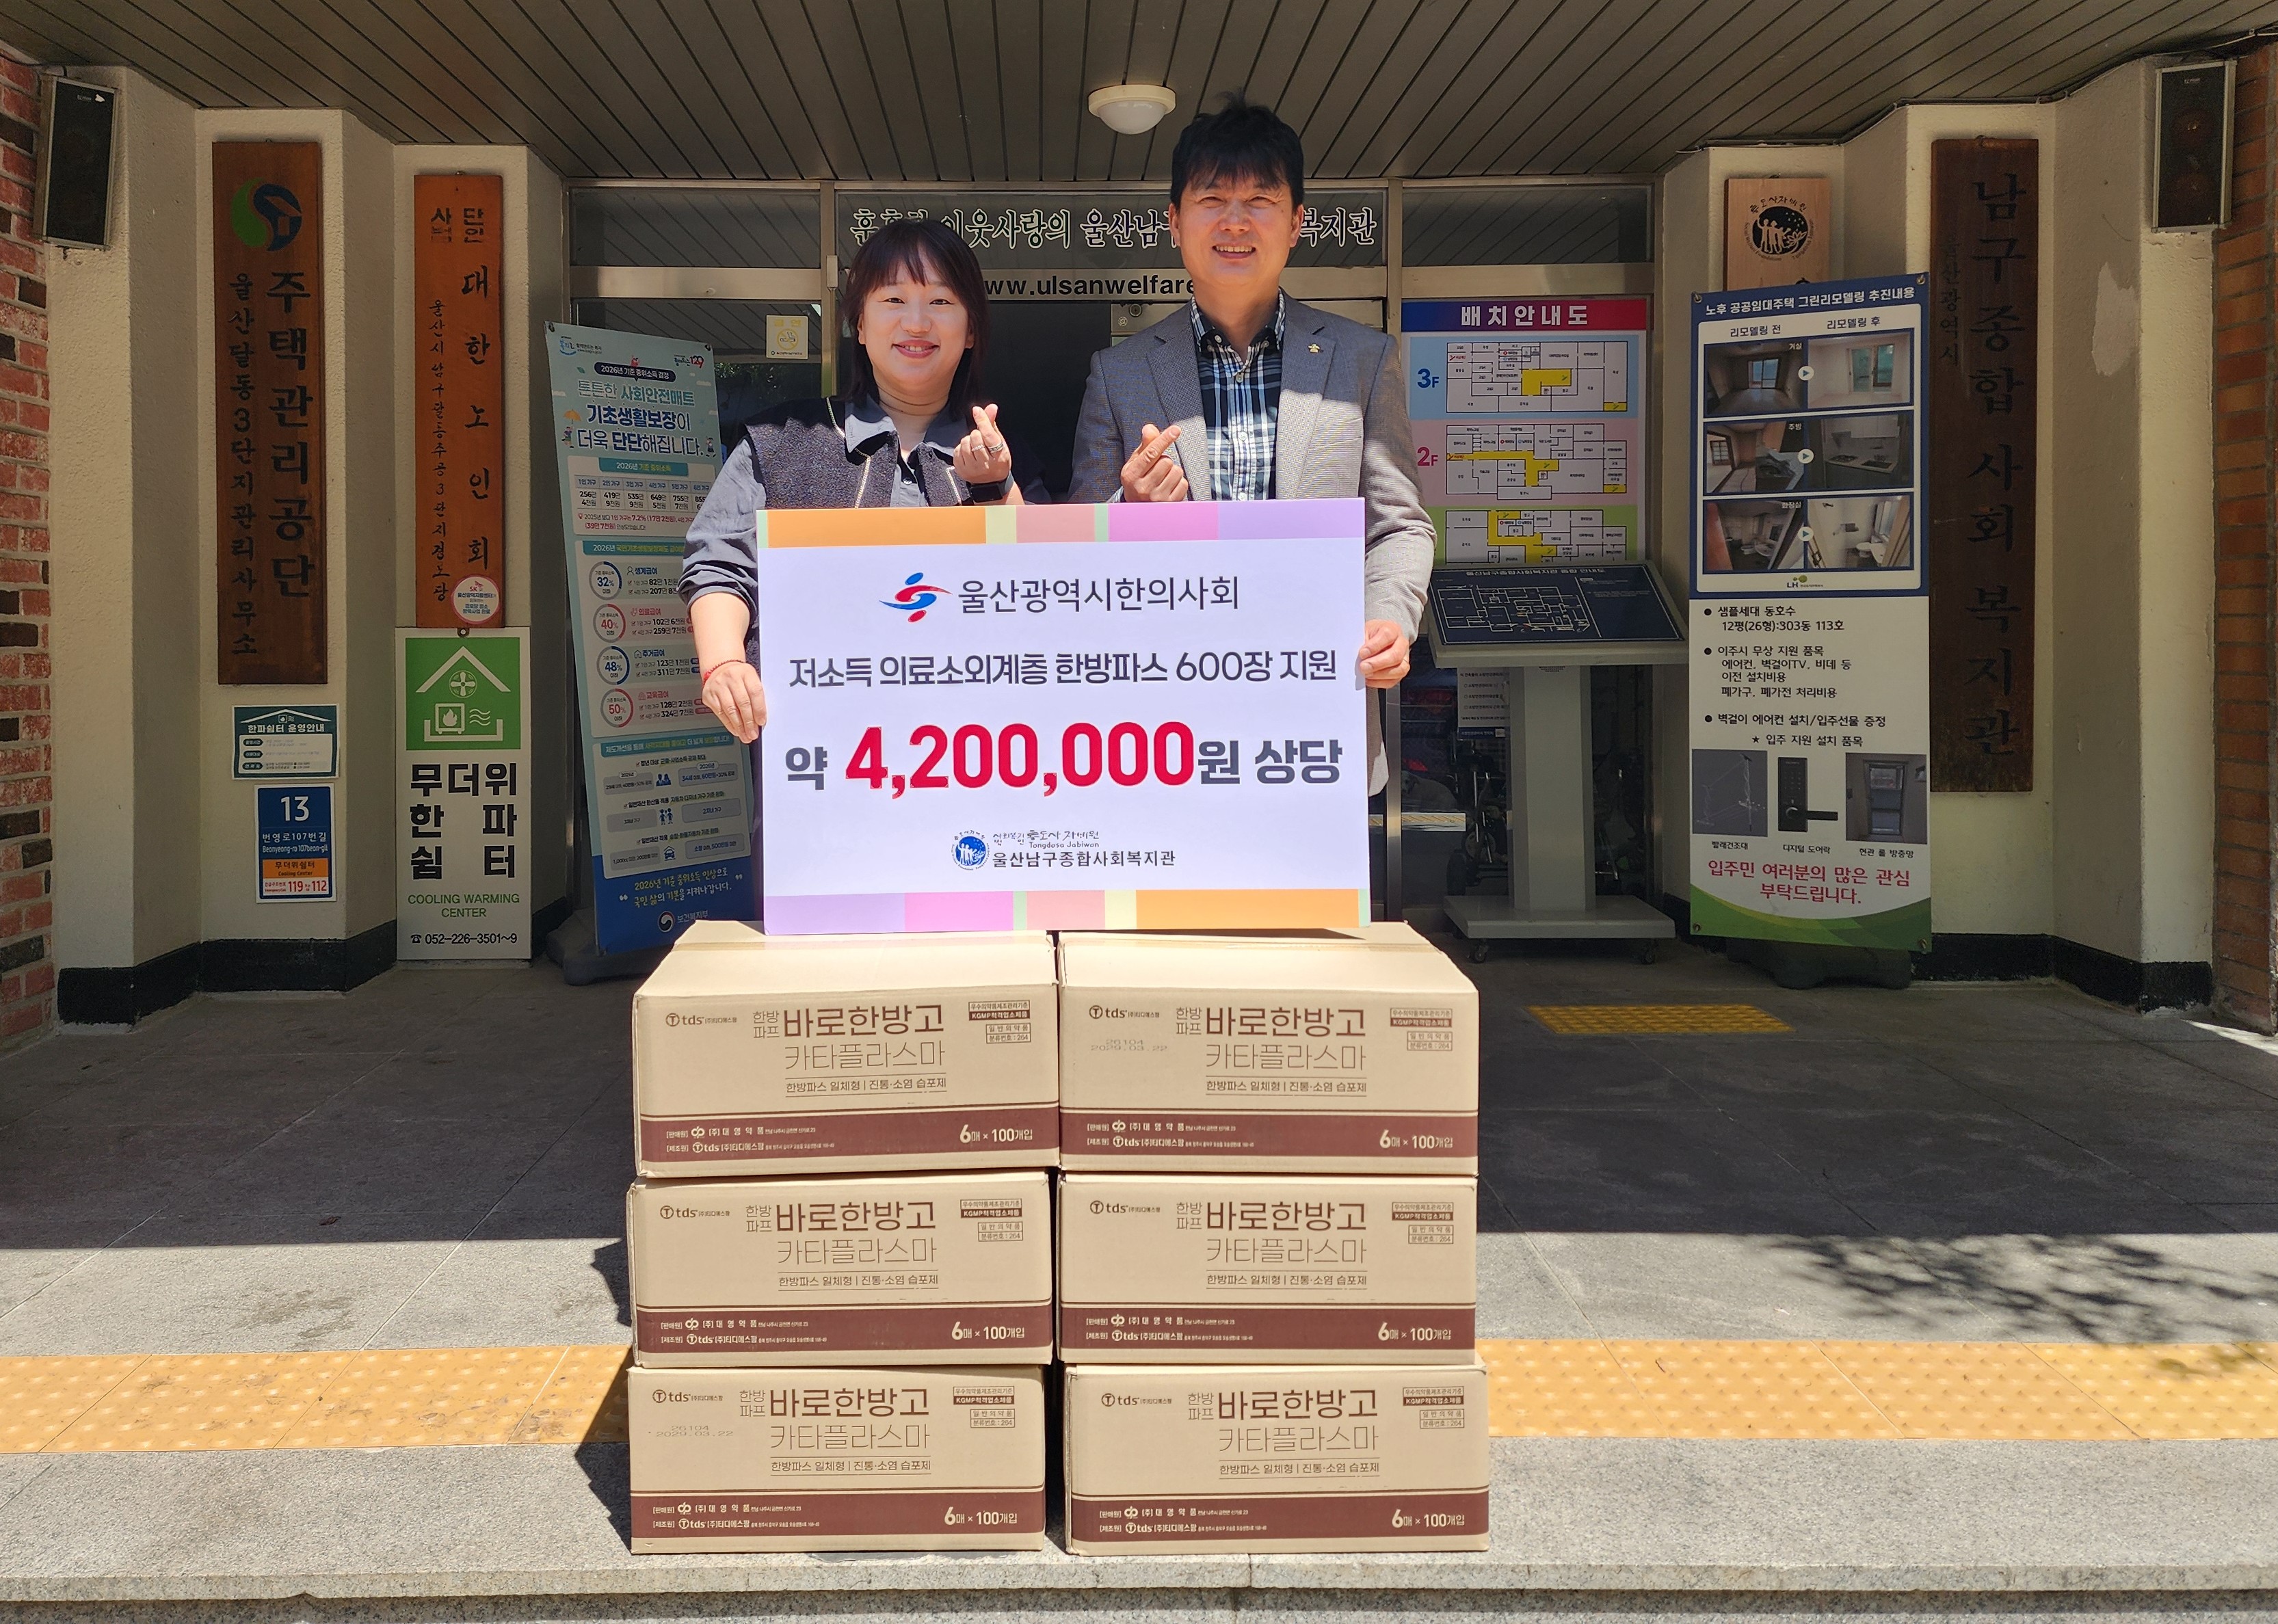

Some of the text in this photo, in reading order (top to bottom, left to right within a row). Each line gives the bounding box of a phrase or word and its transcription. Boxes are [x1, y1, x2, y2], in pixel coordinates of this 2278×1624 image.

[984, 274, 1194, 295] ww.ulsanwelfare
[1706, 287, 1915, 315] 노후 공공임대주택 그린리모델링 추진내용
[1461, 306, 1588, 327] 배치안내도
[1827, 317, 1880, 330] 리모델링 후
[1730, 324, 1781, 337] 리모델링 전
[601, 365, 623, 374] 2026년
[636, 369, 657, 378] 중위소득
[689, 356, 704, 369] 129
[1417, 369, 1439, 388] 3F
[578, 380, 695, 406] 튼튼한 사회안전매트
[461, 265, 490, 571] 대한노인회
[587, 404, 691, 431] 기초생활보장이
[1788, 423, 1802, 431] 주방
[265, 270, 314, 598] 주택관리공단
[577, 429, 703, 455] 더욱 단단해집니다.
[228, 273, 257, 656] 울산달동3단지관리사무소
[1417, 447, 1438, 466] 2F
[1964, 172, 2027, 759] 남구종합사회복지관
[1782, 501, 1801, 509] 화장실
[635, 567, 657, 575] 생계급여
[597, 576, 614, 587] 32%
[958, 576, 1239, 613] 울산광역시한의사회
[1718, 606, 1796, 617] 샘플세대 동호수
[601, 620, 618, 629] 40%
[1816, 620, 1844, 631] 113호
[642, 649, 665, 657] 주거급여
[1718, 646, 1823, 656] 이주시 무상 지원 품목
[605, 661, 622, 672] 48%
[789, 650, 1337, 688] 저소득 의료소외계층 한방파스 600장 지원
[1816, 660, 1836, 669] 비데
[1841, 660, 1851, 670] 등
[1722, 672, 1786, 682] 이전 설치비용
[1761, 687, 1792, 697] 폐가전
[1796, 687, 1838, 698] 처리비용
[609, 704, 626, 715] 50%
[248, 723, 324, 733] 한파쉼터 운영안내
[1718, 714, 1885, 728] 벽걸이 에어컨 설치/입주선물 증정
[1766, 734, 1863, 747] 입주 지원 설치 품목
[785, 745, 828, 790] 약
[845, 721, 1240, 799] 4,200,000원
[1255, 738, 1343, 784] 상당
[410, 762, 517, 797] 무더위
[280, 797, 310, 821] 13
[263, 832, 326, 843] 번영로107번길
[1029, 841, 1064, 849] Tongdosa
[1712, 841, 1749, 851] 빨래건조대
[263, 844, 328, 853] Beonyeong-ro 107beon-gil
[1783, 844, 1831, 854] 디지털 도어락
[1859, 848, 1874, 857] 현관
[1890, 850, 1913, 859] 방충망
[992, 851, 1176, 868] 울산남구종합사회복지관
[635, 868, 728, 890] 2026년 기준 중위소득 인상으로
[1708, 860, 1909, 886] 입주민 여러분의 많은 관심
[288, 881, 303, 892] 119
[312, 880, 327, 892] 112
[635, 883, 732, 907] 국민 삶의 기본을 지켜나갑니다.
[1760, 883, 1862, 904] 부탁드립니다.
[408, 894, 520, 905] COOLING WARMING
[441, 908, 487, 918] CENTER
[677, 910, 708, 922] 보건복지부
[784, 1004, 944, 1039] 바로한방고
[1206, 1007, 1366, 1037] 바로한방고
[785, 1042, 945, 1071] 카타플라스마
[1206, 1043, 1366, 1070] 카타플라스마
[959, 1124, 1033, 1144] 6매 100개입
[1379, 1129, 1453, 1149] 6매 100개입
[776, 1201, 936, 1233] 바로한방고
[1206, 1201, 1366, 1231] 바로한방고
[777, 1238, 938, 1265] 카타플라스마
[1206, 1238, 1366, 1263] 카타플라스마
[951, 1321, 1024, 1340] 6매 100개입
[1377, 1322, 1451, 1341] 6매 100개입
[668, 1392, 689, 1402] tds
[739, 1390, 765, 1402] 한방
[771, 1388, 930, 1418] 바로한방고
[1219, 1389, 1378, 1420] 바로한방고
[740, 1405, 765, 1417] 파프
[771, 1424, 929, 1450] 카타플라스마
[1219, 1426, 1378, 1452] 카타플라스마
[771, 1461, 812, 1472] 한방파스
[814, 1461, 845, 1472] 일체형
[901, 1460, 931, 1472] 습포제
[944, 1506, 1017, 1526] 6매 100개입
[1392, 1509, 1465, 1529] 6매 100개입
